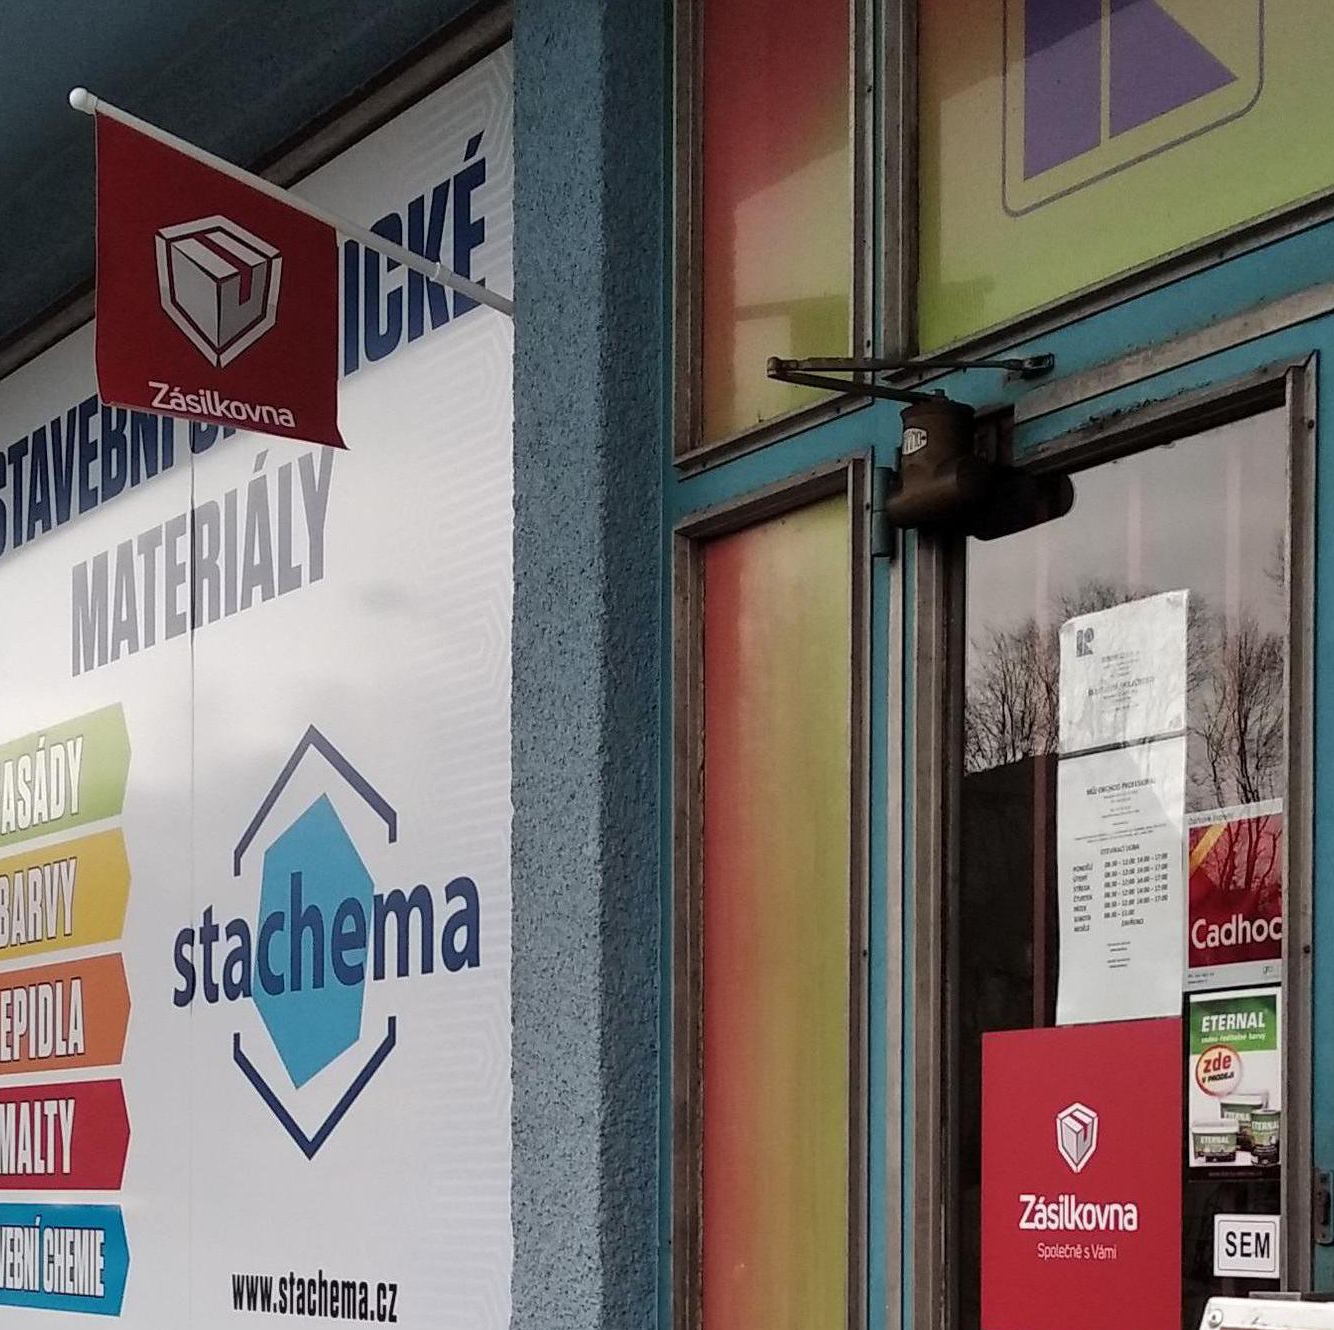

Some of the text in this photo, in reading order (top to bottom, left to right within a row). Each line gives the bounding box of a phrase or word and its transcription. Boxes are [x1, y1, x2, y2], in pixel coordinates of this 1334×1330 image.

[148, 381, 296, 428] Zásilkovna
[72, 447, 334, 677] MATERIÁLY
[173, 872, 480, 1008] stachema
[1191, 913, 1283, 949] Cadhoc
[1202, 1012, 1266, 1033] ETERNAL
[1203, 1051, 1232, 1073] zde
[1019, 1194, 1138, 1232] Zásilkovna
[43, 1228, 104, 1297] CHEMIE
[1037, 1242, 1117, 1261] Společně s Vámi
[1225, 1231, 1271, 1259] SEM
[232, 1270, 398, 1323] www.stachema.cz
